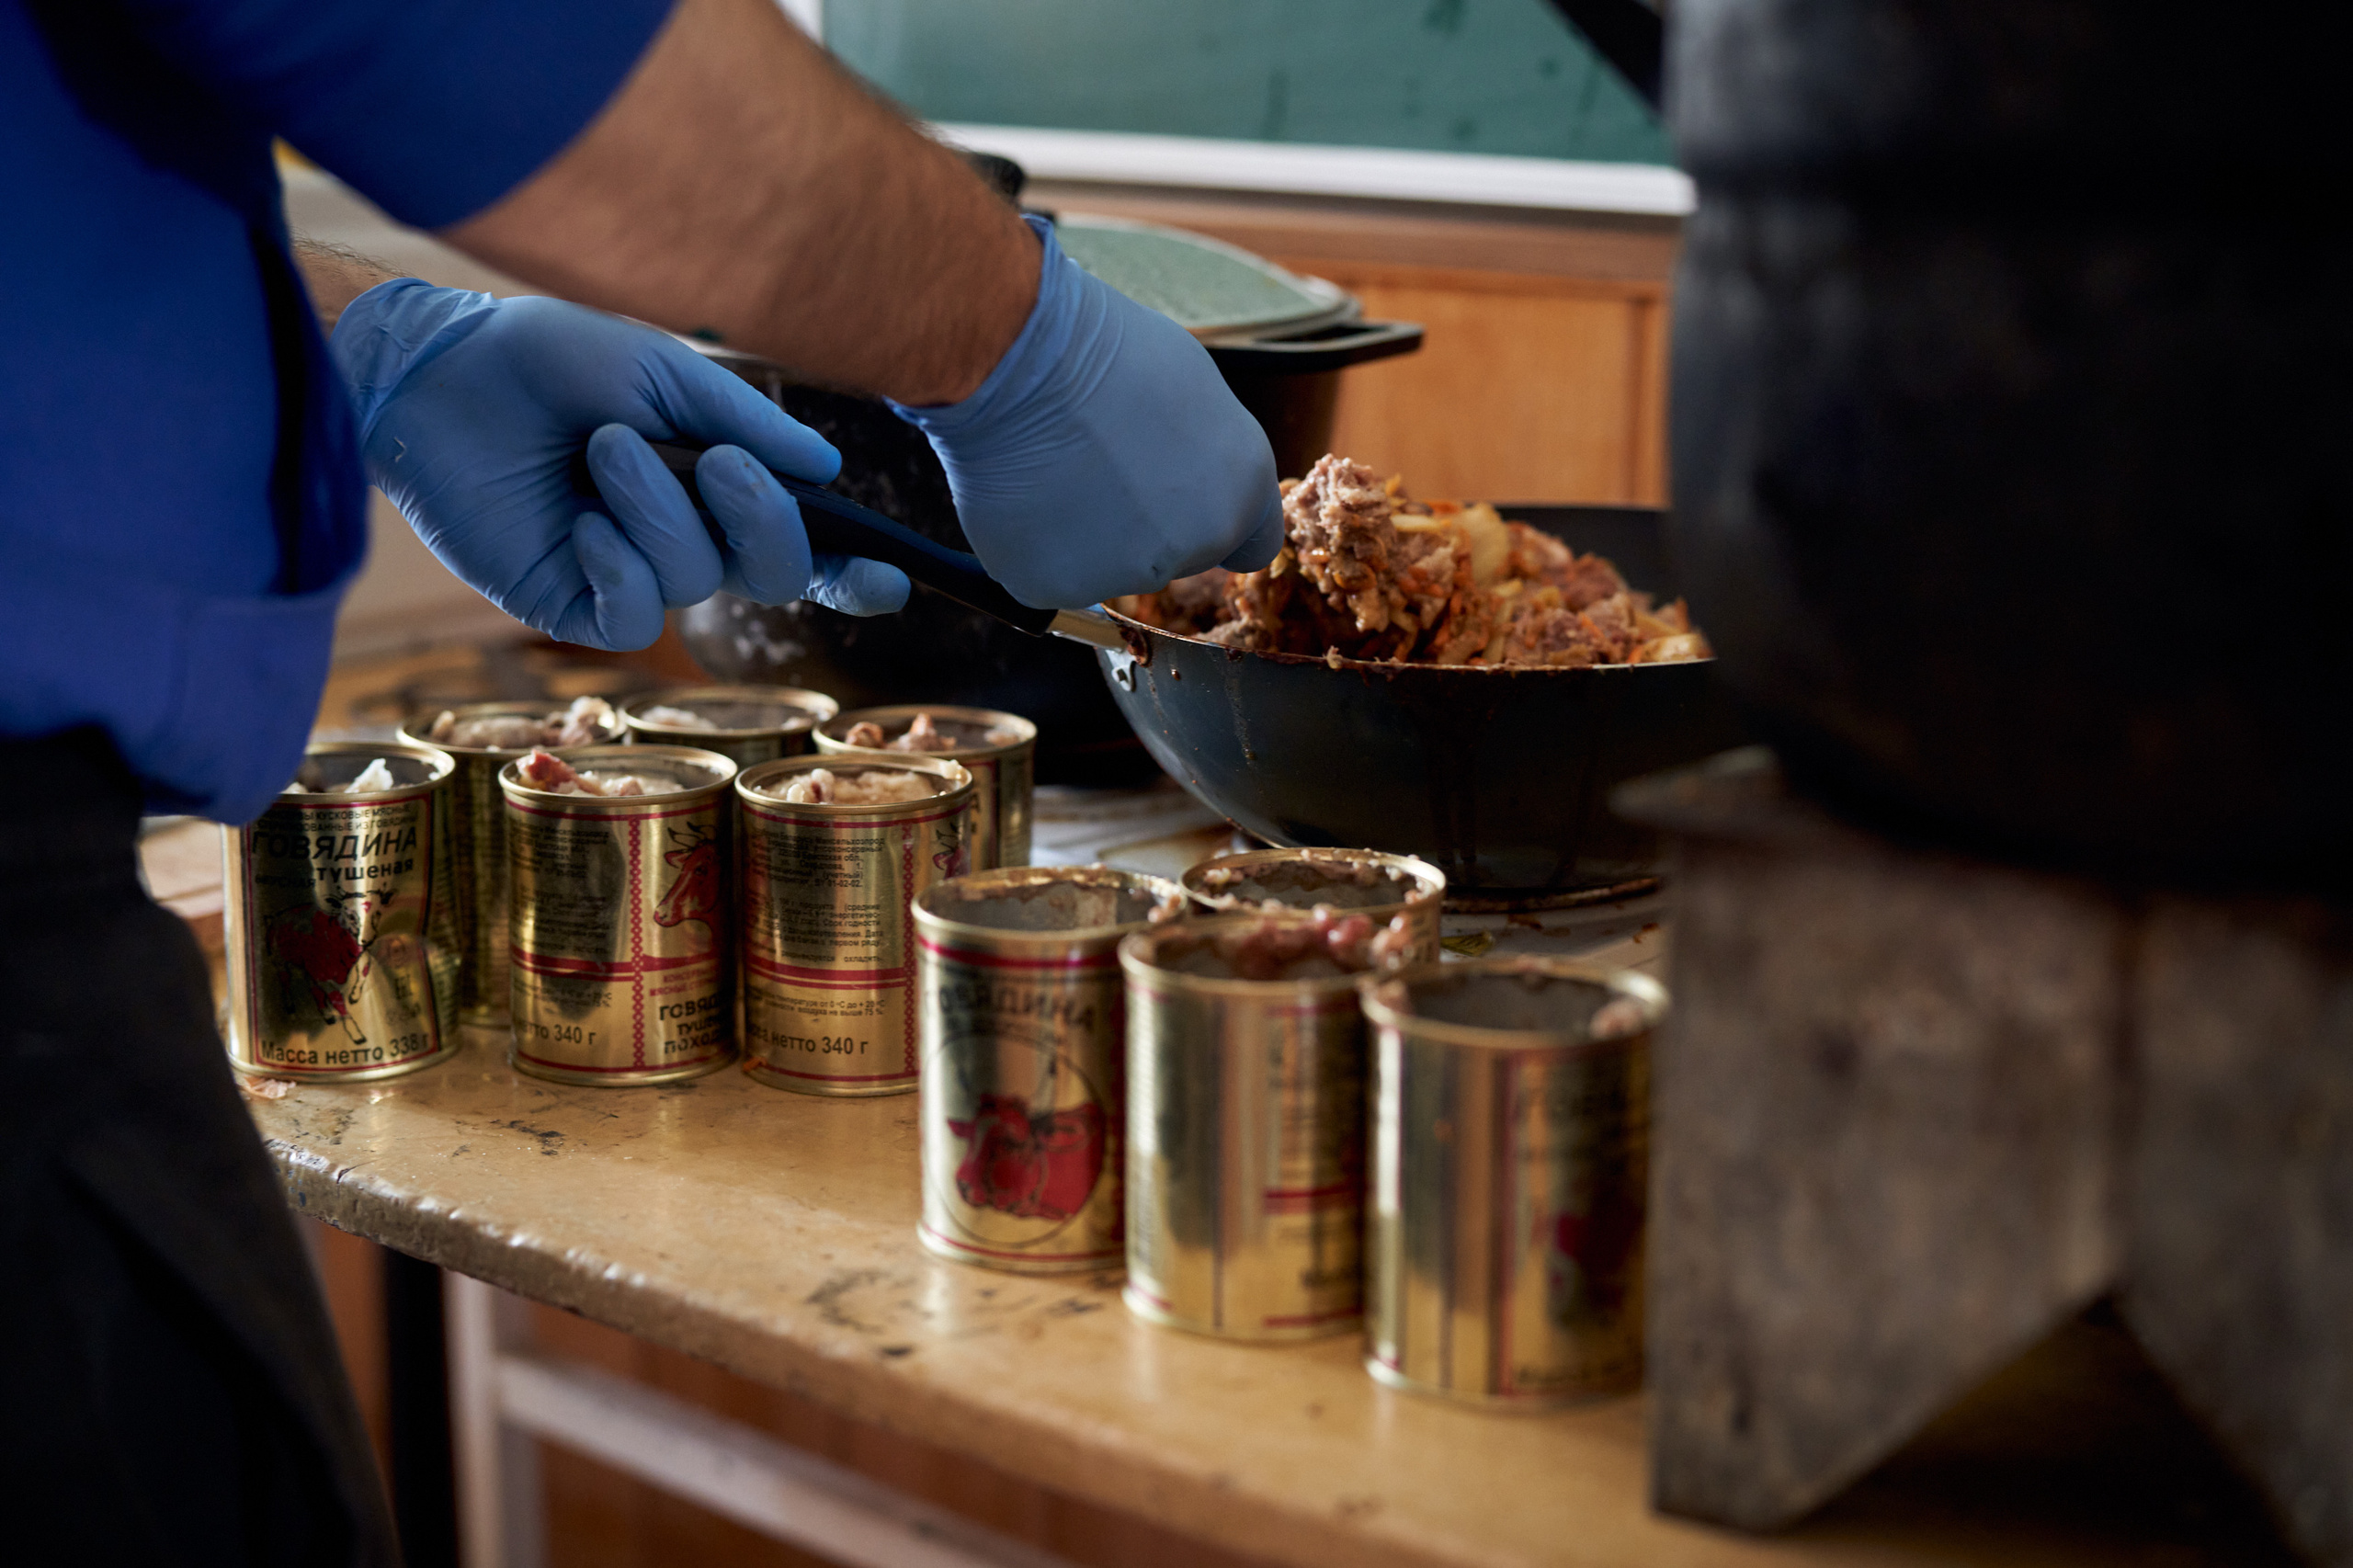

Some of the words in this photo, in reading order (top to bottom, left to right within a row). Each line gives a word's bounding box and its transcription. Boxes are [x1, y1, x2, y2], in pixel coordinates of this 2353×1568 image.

[252, 826, 417, 862] ГОВЯДИНА
[316, 858, 414, 882] тушеная
[554, 1024, 583, 1044] 340
[588, 1032, 597, 1046] г
[771, 1031, 815, 1052] нетто
[822, 1036, 854, 1055] 340
[860, 1040, 869, 1054] г
[261, 1040, 318, 1064] Масса
[325, 1046, 384, 1064] нетто
[390, 1033, 420, 1057] 338
